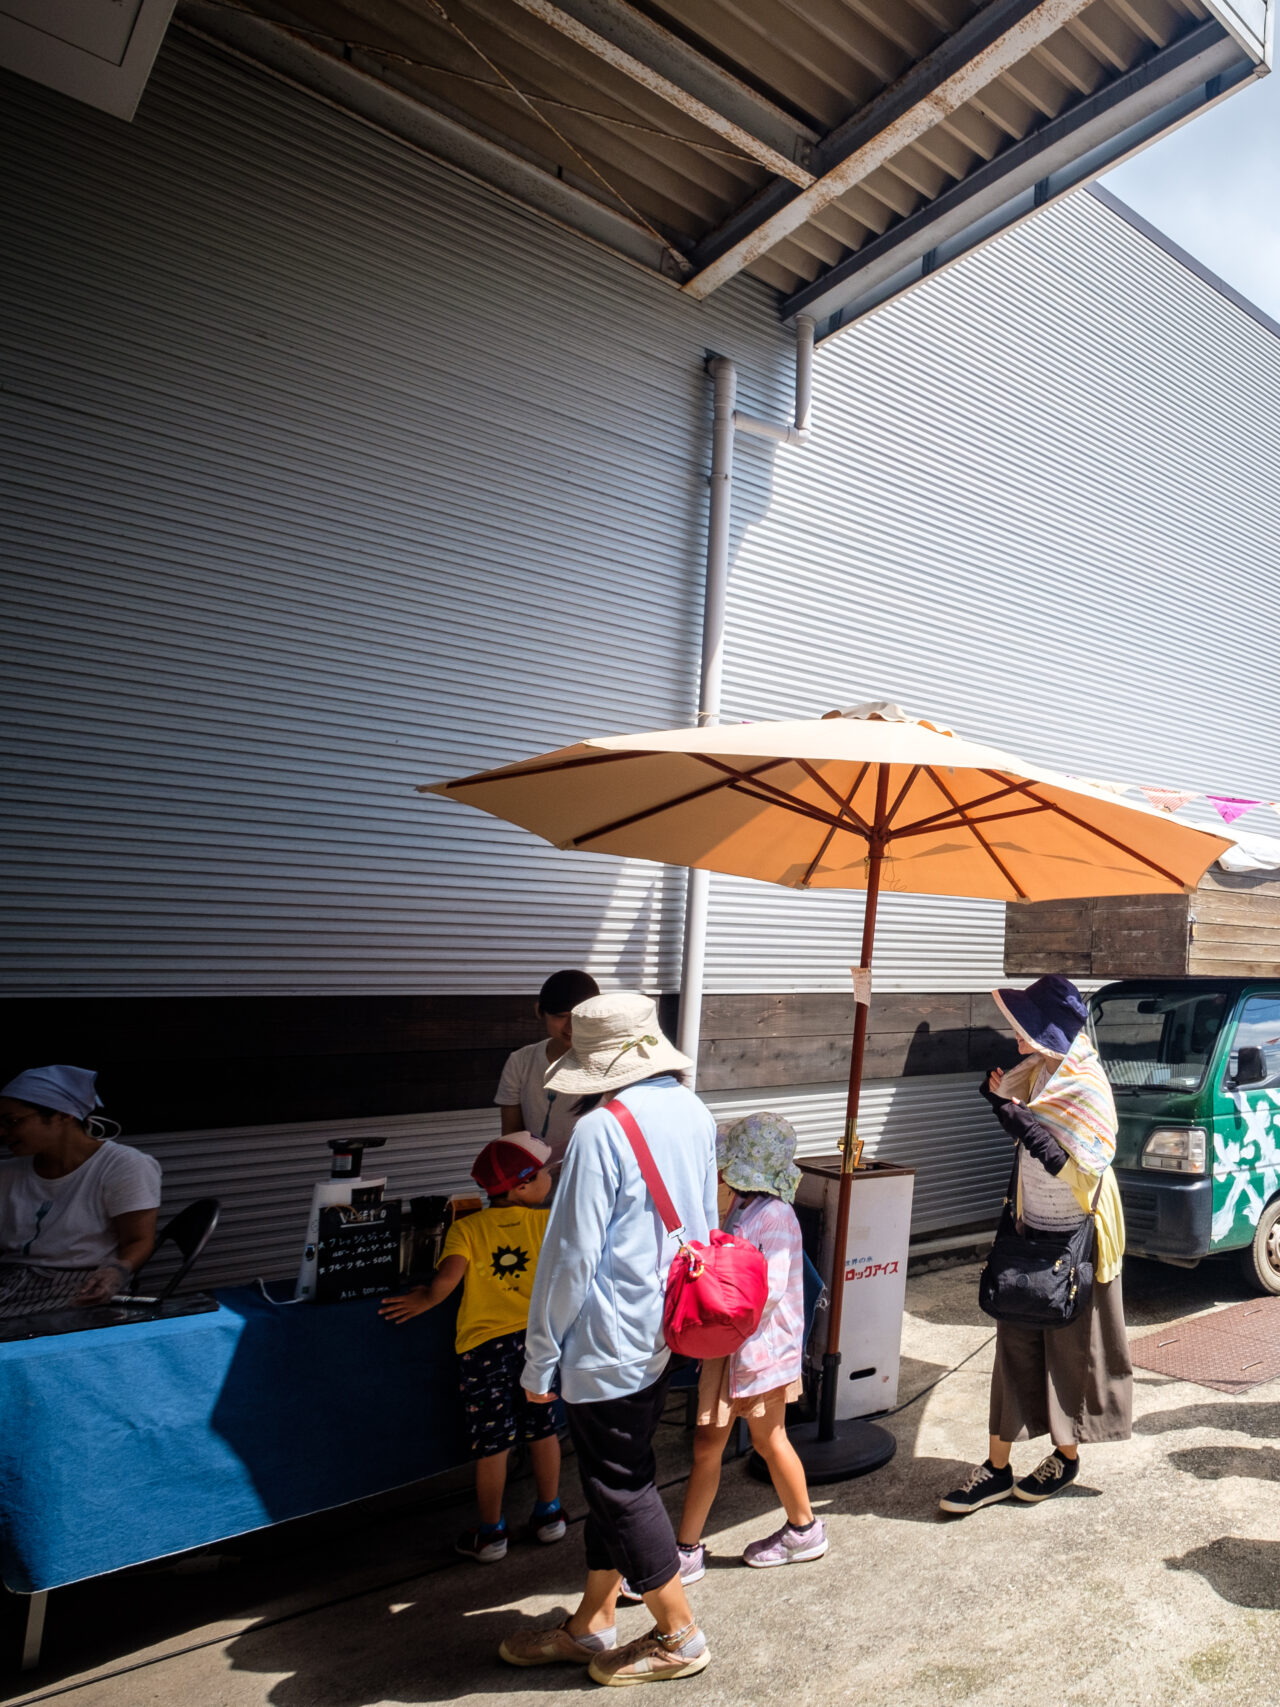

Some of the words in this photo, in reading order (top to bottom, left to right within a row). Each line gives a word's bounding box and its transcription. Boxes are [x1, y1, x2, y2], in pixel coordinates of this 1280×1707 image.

[845, 1261, 899, 1281] ロックアイス
